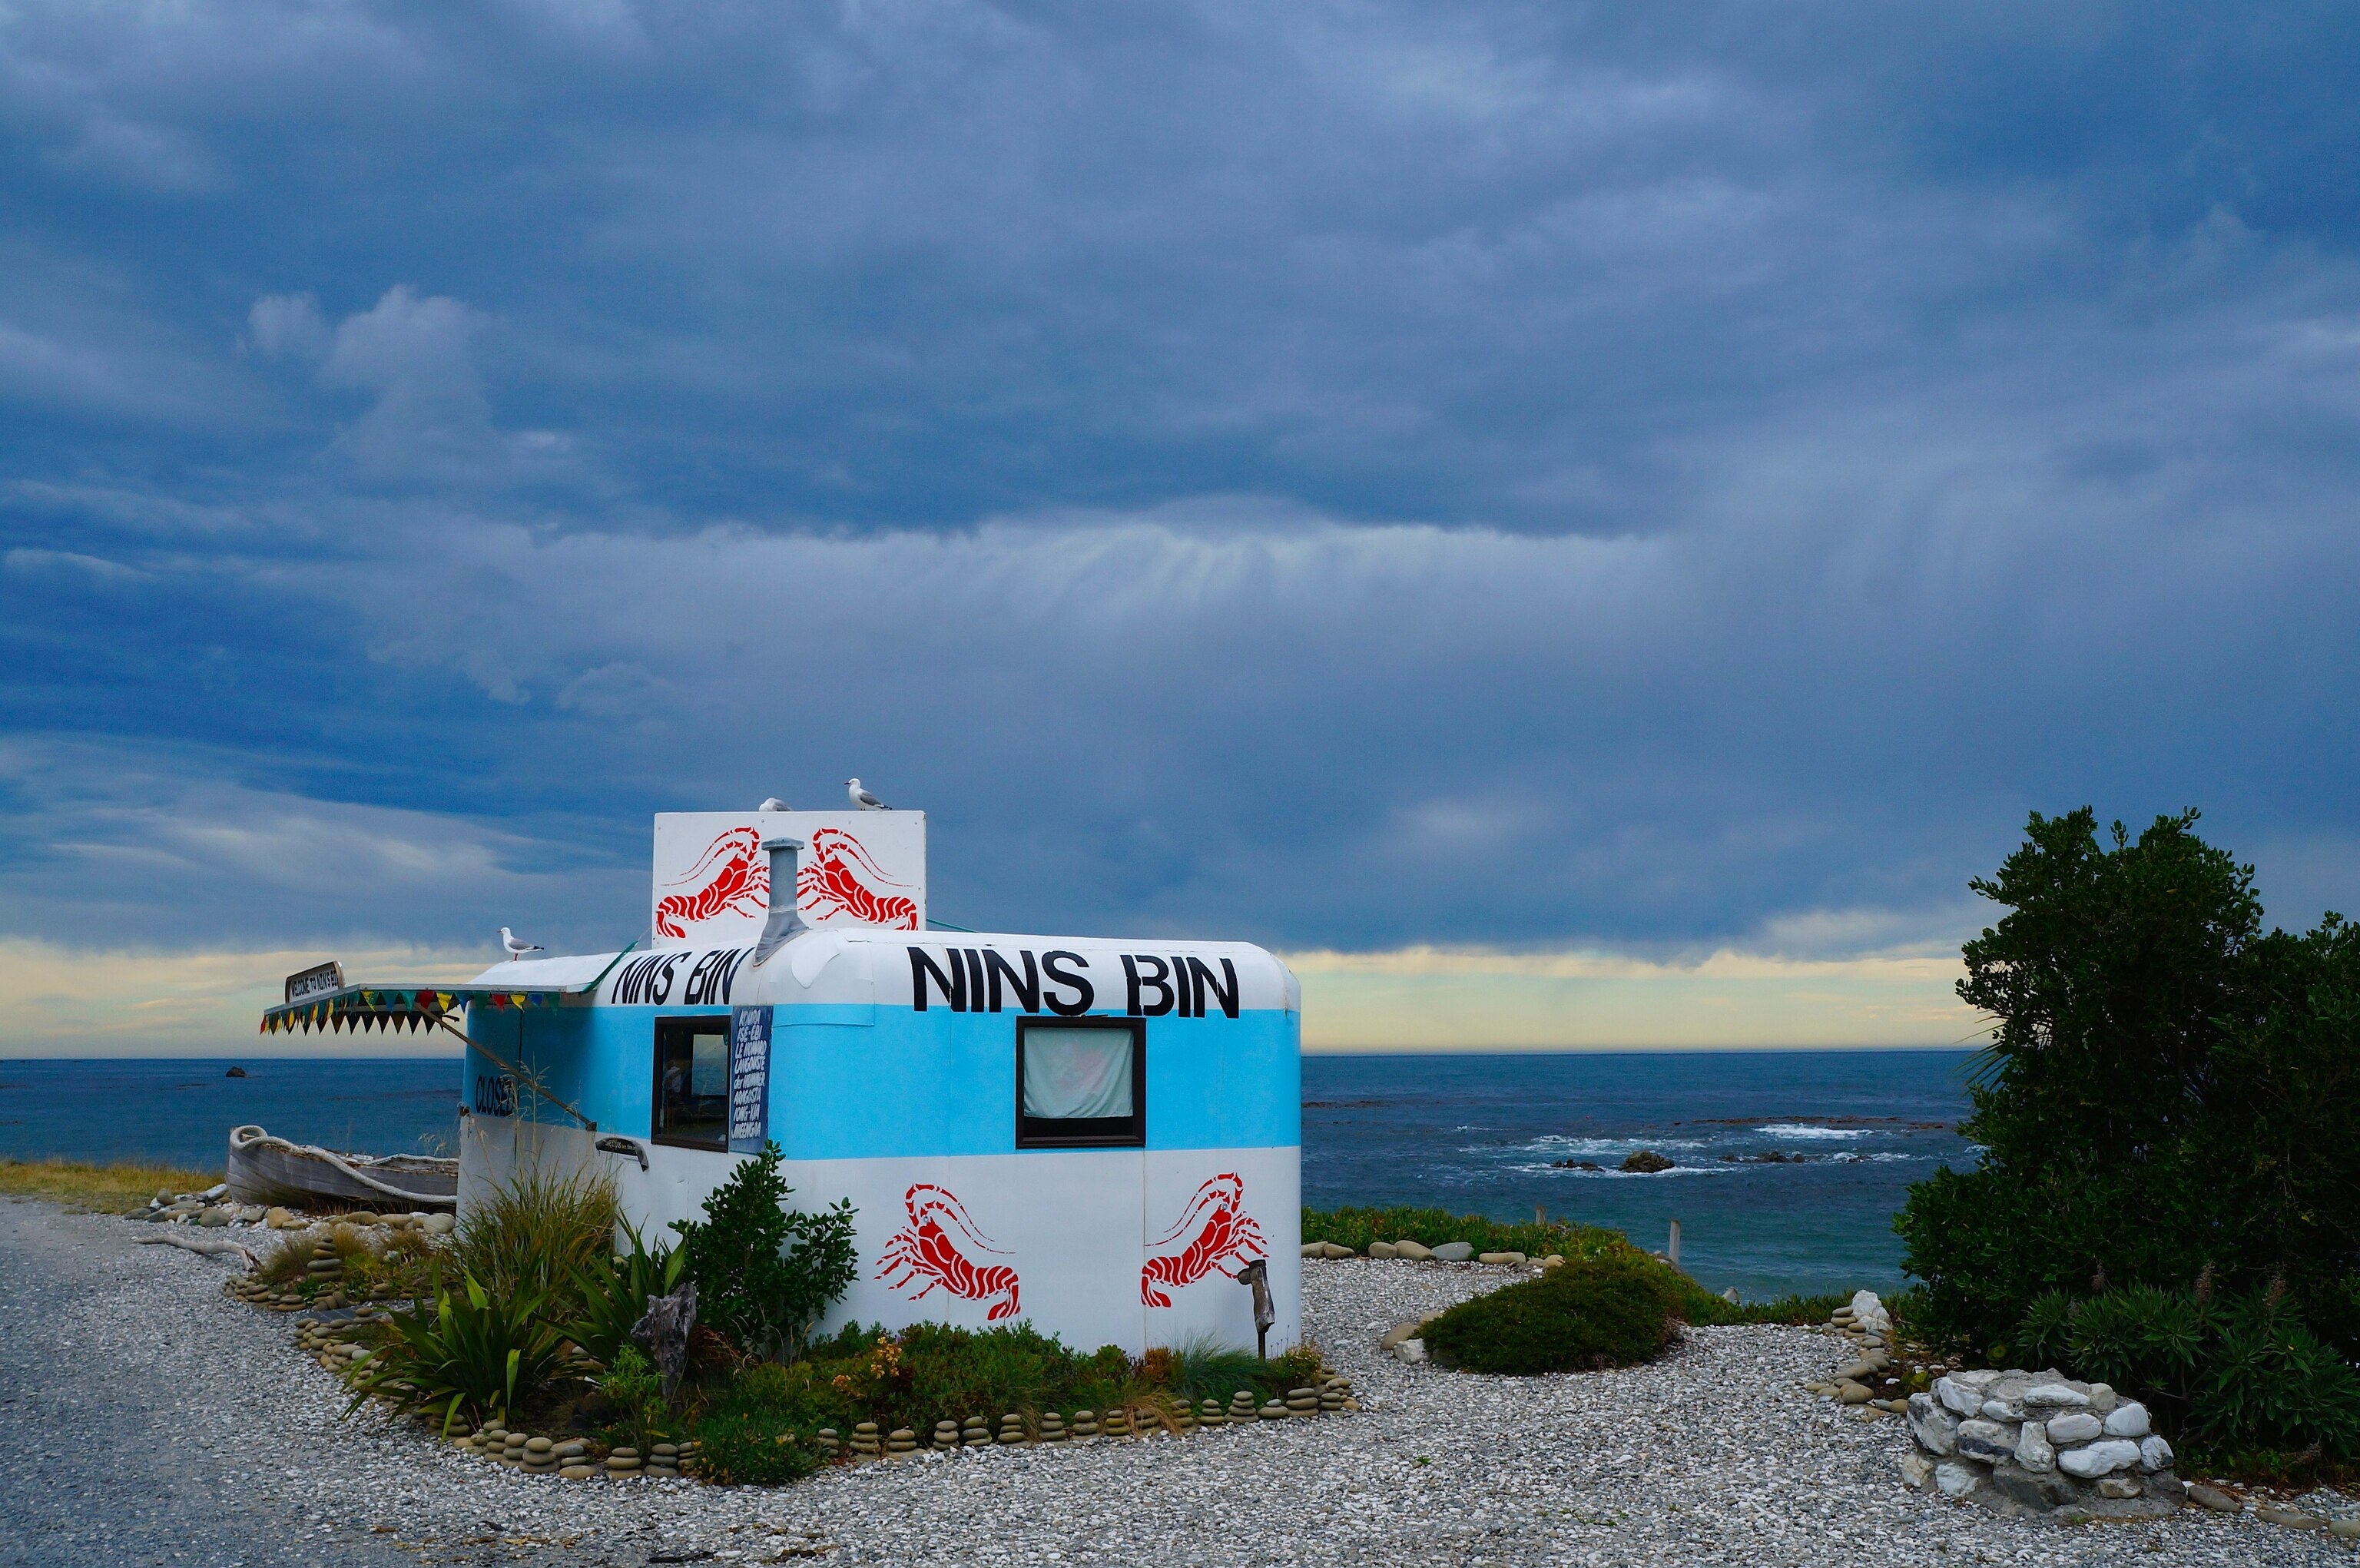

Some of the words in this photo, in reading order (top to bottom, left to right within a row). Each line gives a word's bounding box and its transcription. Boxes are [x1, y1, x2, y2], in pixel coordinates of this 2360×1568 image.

[291, 977, 310, 996] WELCOME
[310, 976, 317, 990] TO
[612, 952, 692, 1005] NINS
[684, 947, 755, 1005] BIN
[907, 947, 1095, 1016] NINS
[1119, 955, 1239, 1019] BIN
[735, 1043, 744, 1059] LE
[475, 1075, 518, 1116] CLOSED
